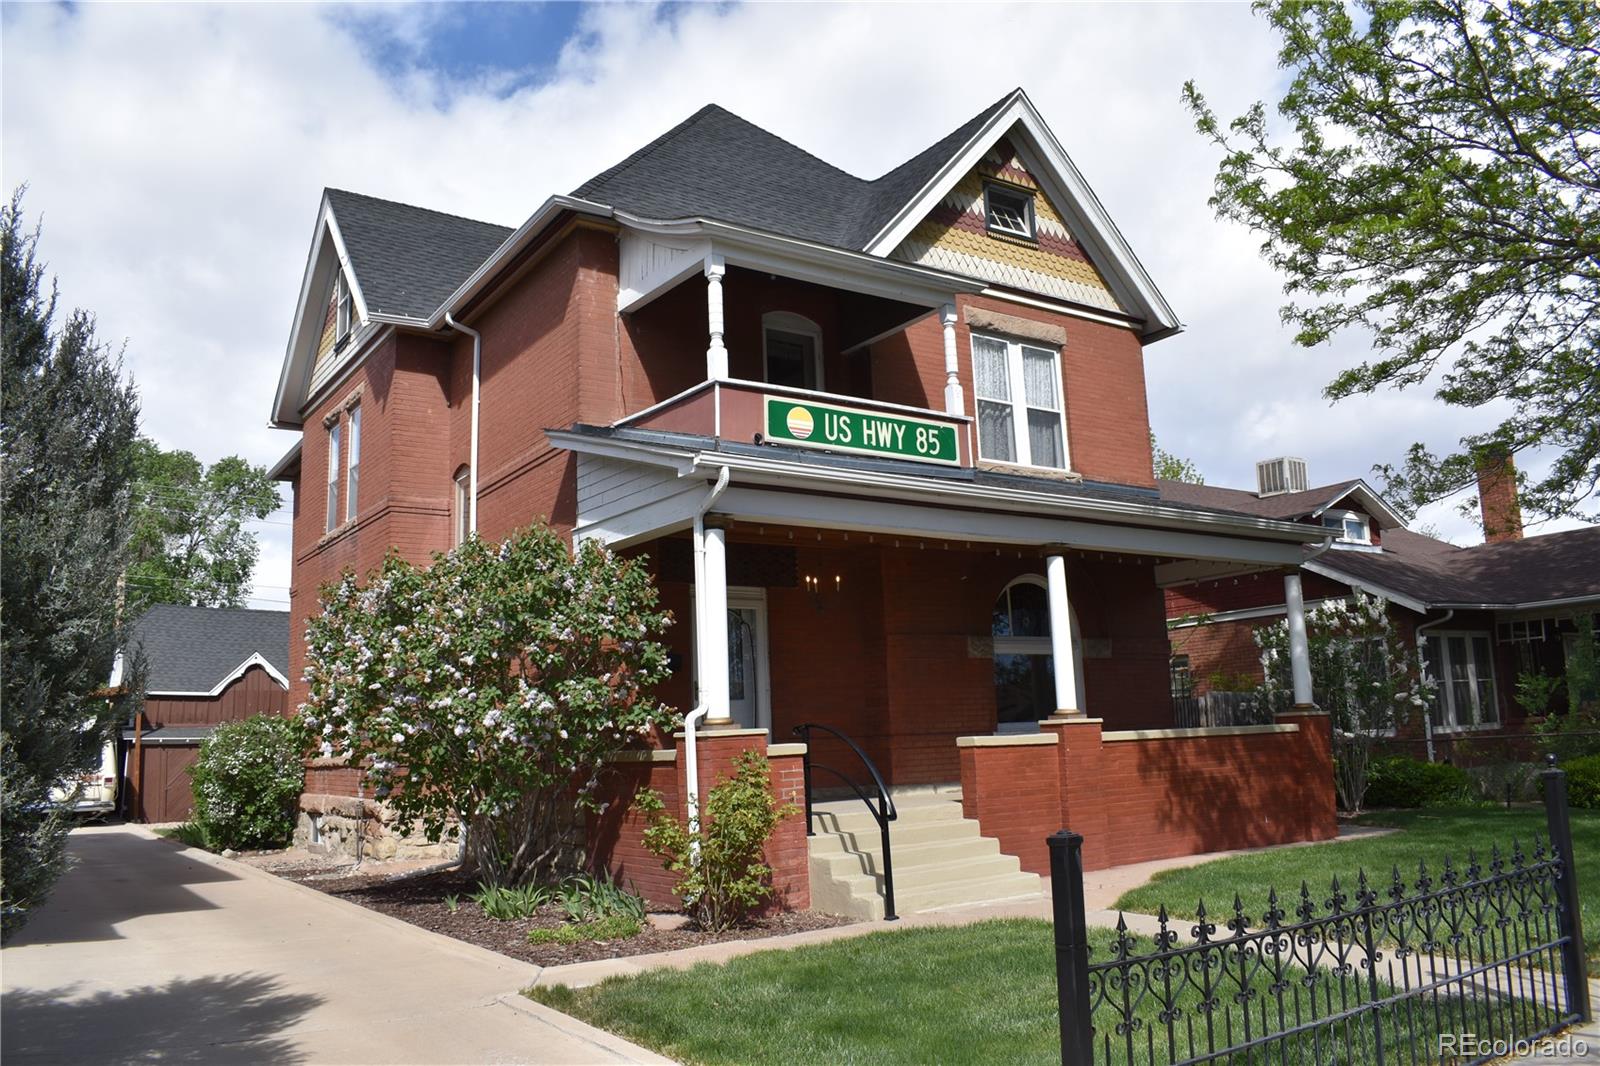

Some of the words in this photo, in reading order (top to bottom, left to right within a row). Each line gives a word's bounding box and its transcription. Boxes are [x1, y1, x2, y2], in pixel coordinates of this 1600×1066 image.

[825, 413, 851, 442] US
[863, 419, 905, 449] HWY
[916, 427, 940, 454] 85
